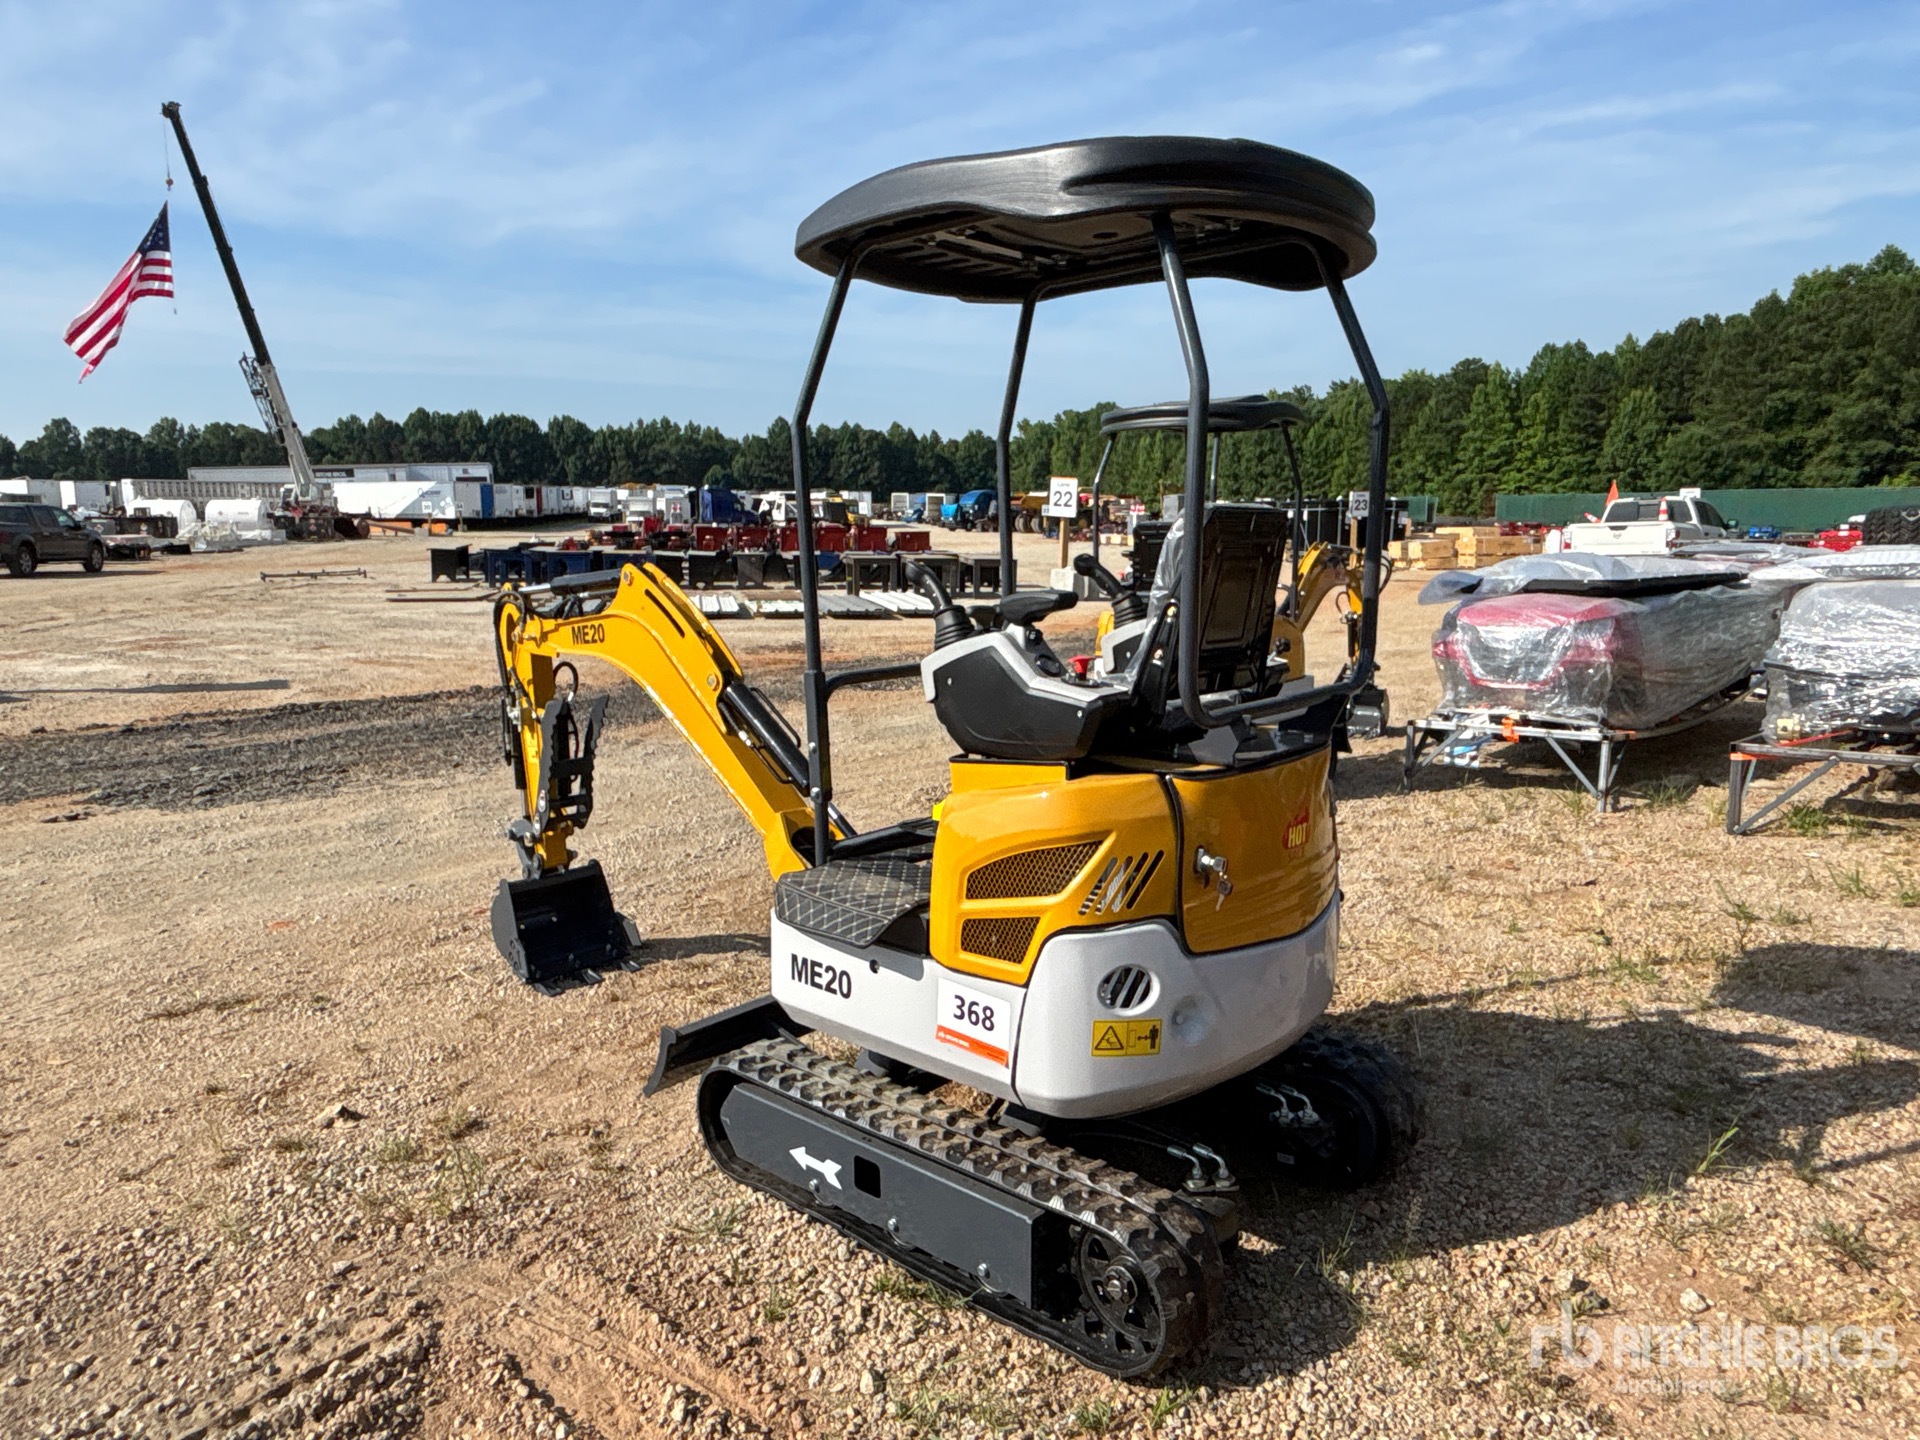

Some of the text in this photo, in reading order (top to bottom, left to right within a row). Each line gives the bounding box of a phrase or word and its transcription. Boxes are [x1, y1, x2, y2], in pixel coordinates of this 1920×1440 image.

[1053, 491, 1073, 507] 22
[1354, 499, 1368, 511] 23
[571, 623, 605, 645] ME20
[1288, 822, 1308, 849] HOT
[791, 953, 851, 999] ME20
[953, 995, 995, 1031] 368
